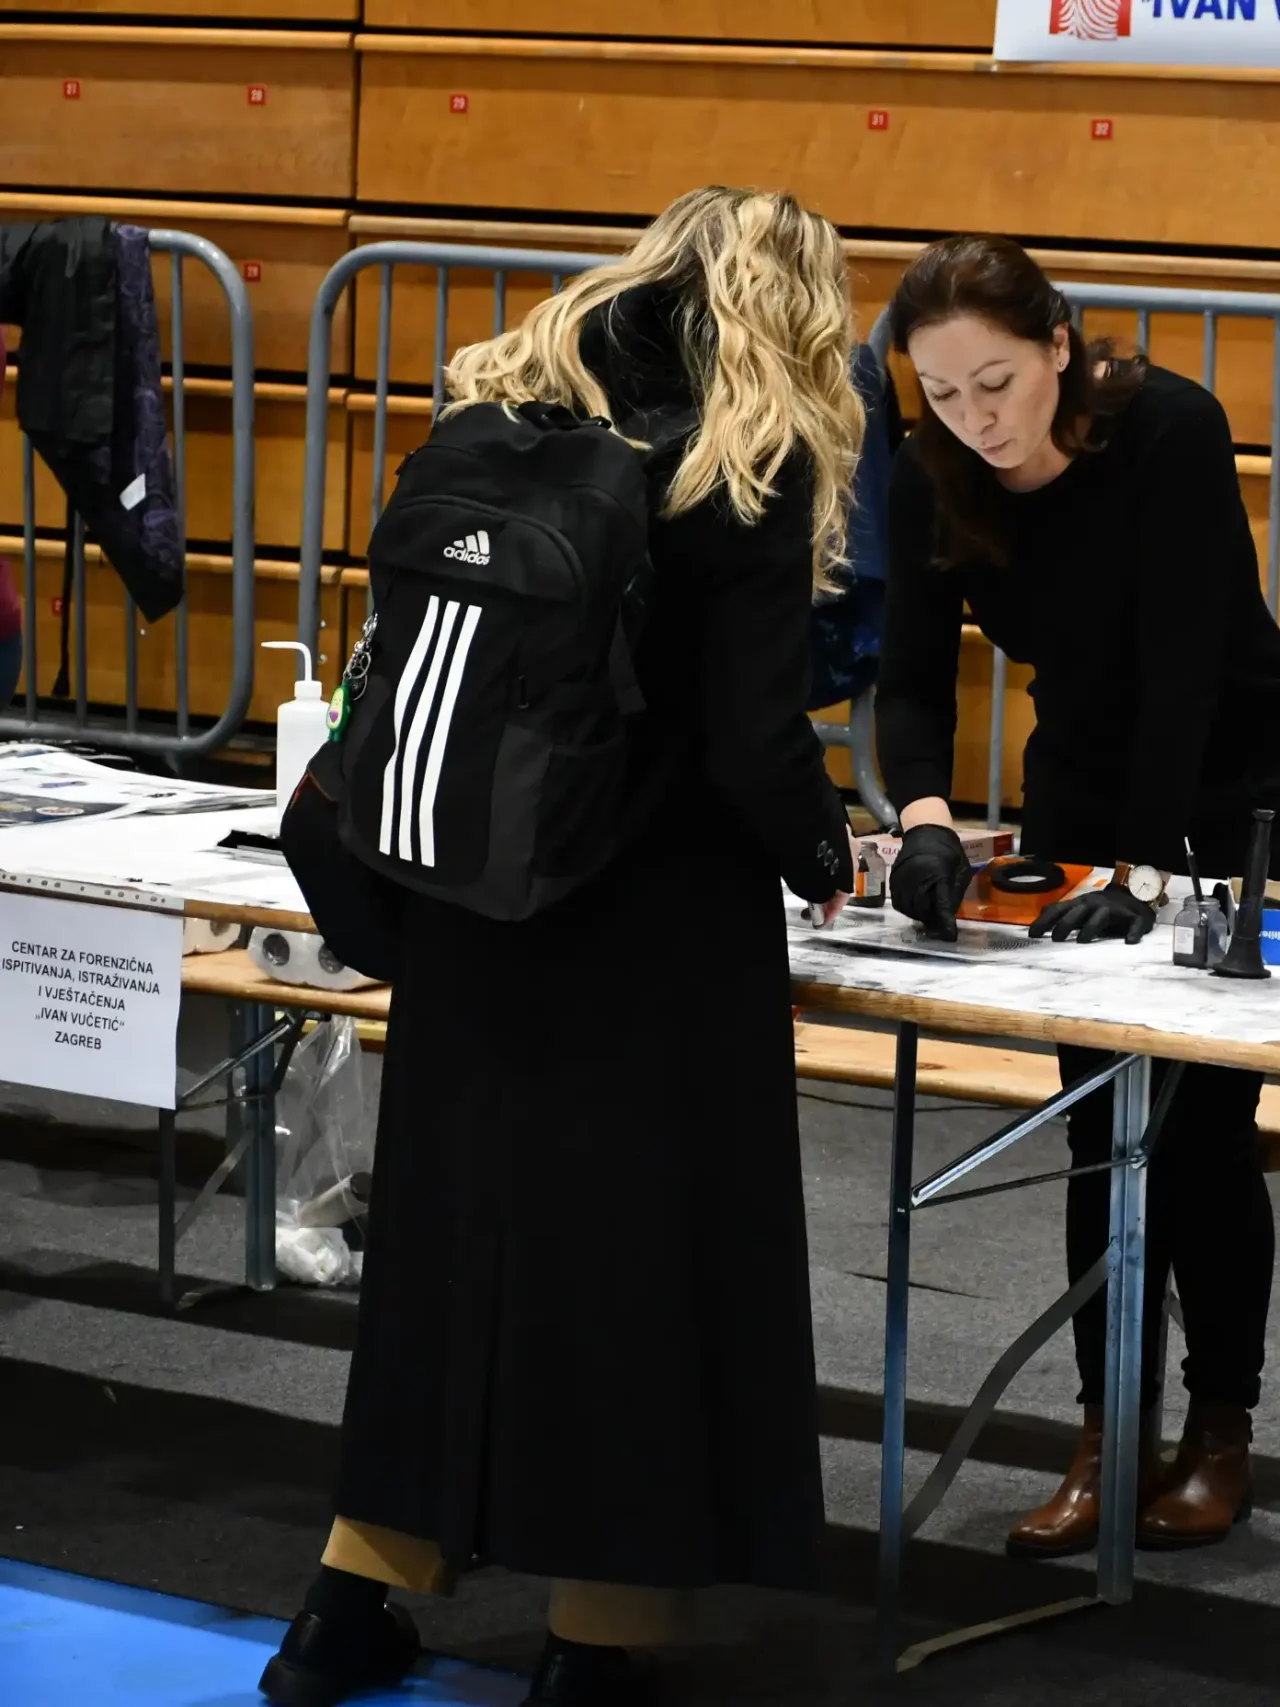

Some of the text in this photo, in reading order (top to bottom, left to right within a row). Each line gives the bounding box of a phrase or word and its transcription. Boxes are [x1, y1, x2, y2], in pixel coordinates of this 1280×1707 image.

[443, 546, 490, 566] adidas
[12, 941, 154, 974] CENTAR ZA FORENZIČNA
[2, 958, 160, 994] ISPITIVANJA, ISTRAŽIVANJA
[38, 985, 126, 1011] I VJEŠTAČENJA
[35, 1007, 125, 1032] „IVAN VUČETIĆ“
[54, 1030, 102, 1050] ZAGREB
